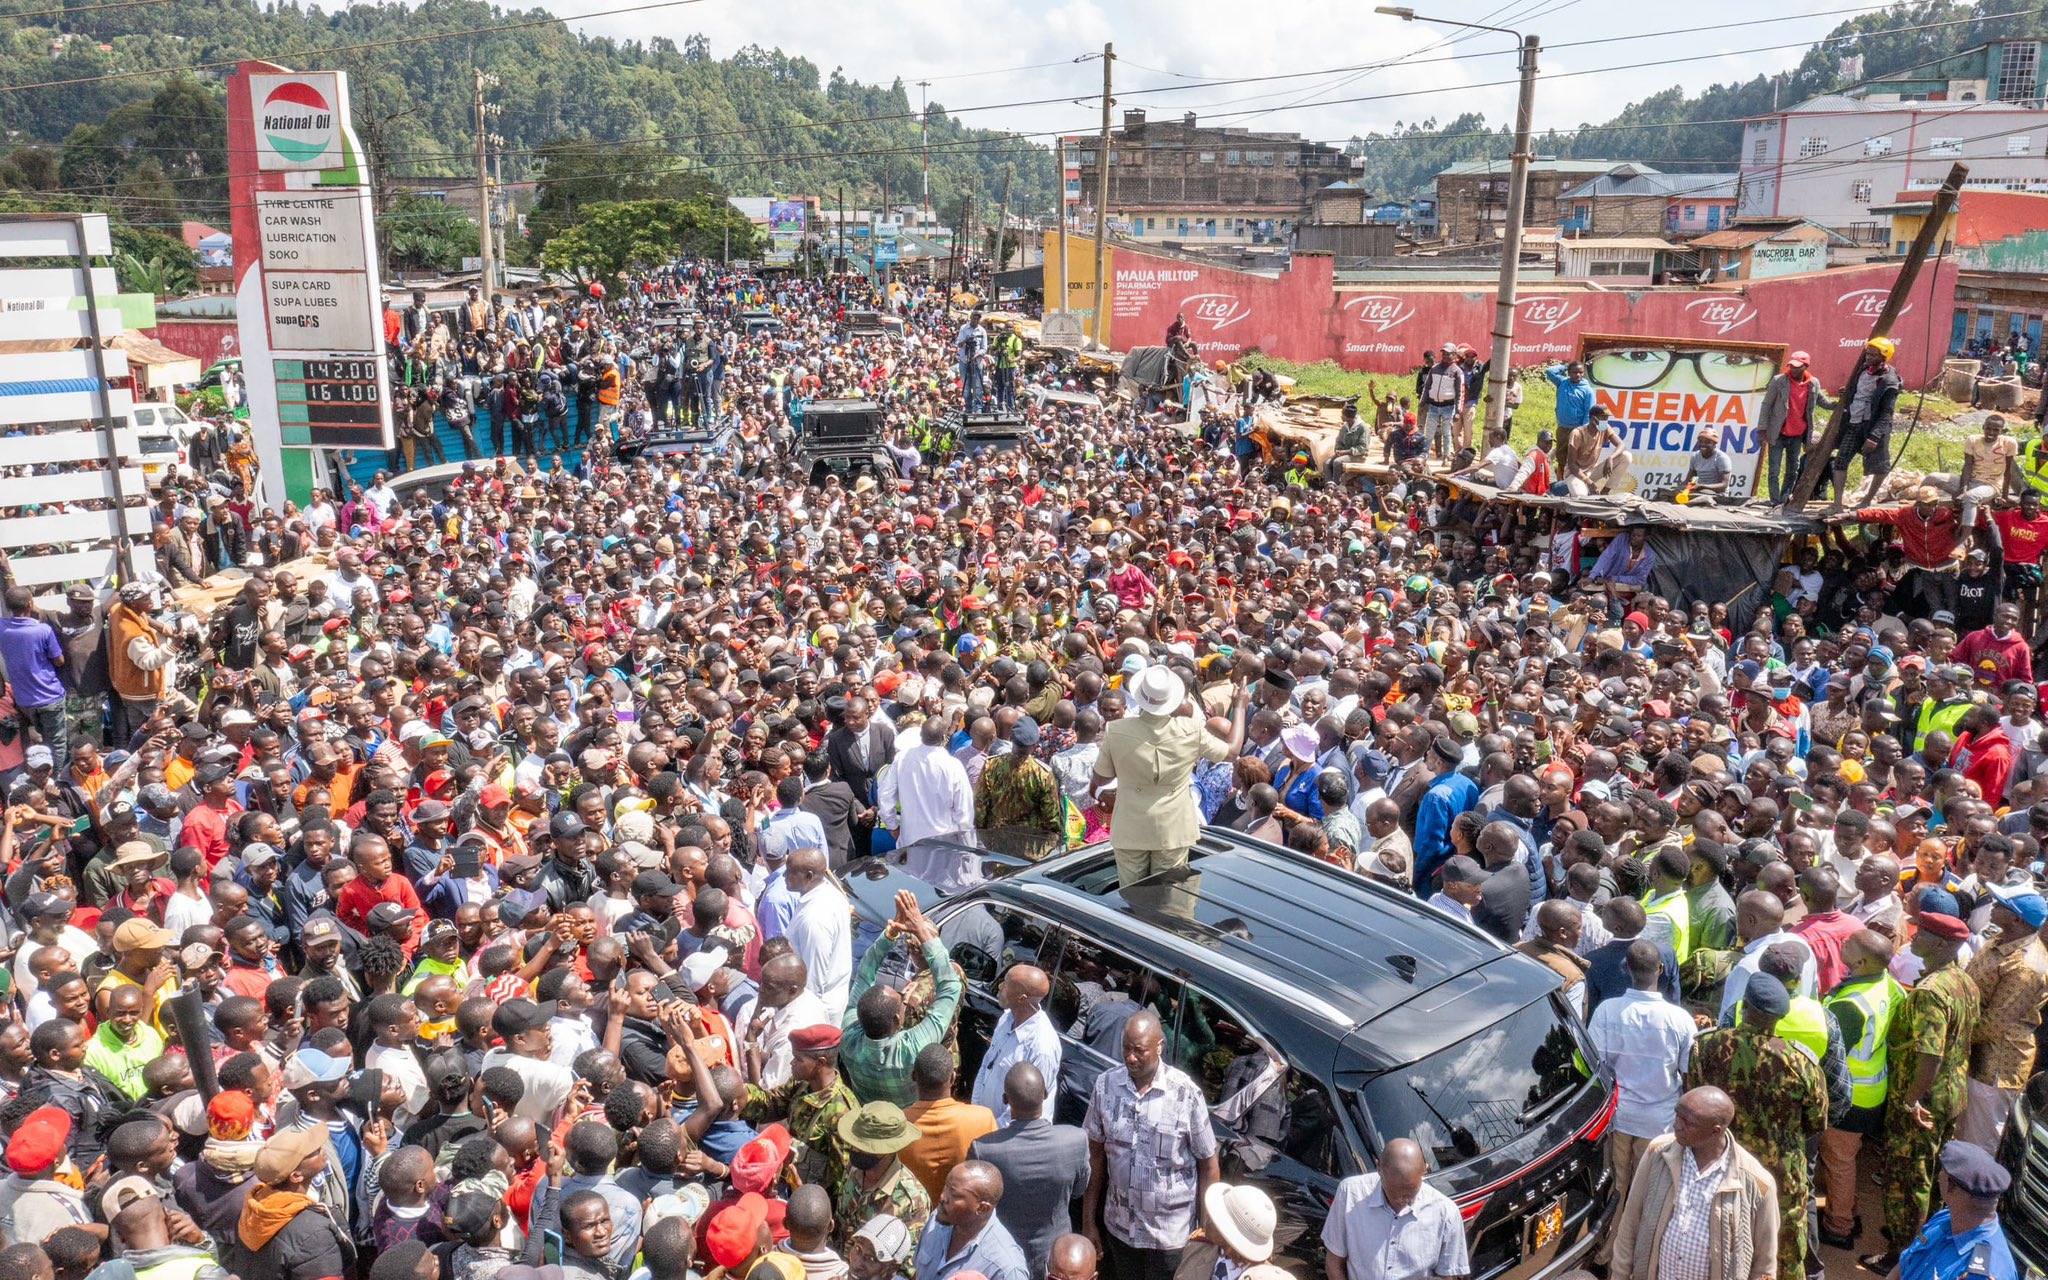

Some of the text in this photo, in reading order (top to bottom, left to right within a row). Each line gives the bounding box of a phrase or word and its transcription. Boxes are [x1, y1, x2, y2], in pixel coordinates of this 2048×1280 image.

[263, 114, 331, 130] National Oil
[264, 200, 334, 209] TYRE CENTRE
[265, 216, 321, 225] CAR WASH
[266, 233, 337, 242] LUBRICATION
[269, 250, 299, 259] SOKO
[1799, 248, 1816, 258] BAR
[1116, 270, 1199, 282] MAUA HILLTOP
[272, 281, 331, 290] SUPA CARD
[7, 300, 45, 311] National Oil
[273, 297, 337, 307] SUPA LUBES
[1196, 299, 1240, 318] itel
[1855, 295, 1888, 313] ite
[1360, 300, 1404, 320] itel
[1524, 301, 1569, 320] itel
[1701, 302, 1746, 320] itel
[275, 314, 320, 328] supaGAS
[1211, 342, 1241, 351] Phone
[1345, 342, 1405, 352] Smart Phone
[1512, 342, 1572, 352] Smart Phone
[309, 362, 375, 379] 142.00
[311, 384, 377, 401] 161.00
[1595, 389, 1748, 424] NEEMA
[1600, 420, 1762, 454] PTICINS
[1508, 1159, 1579, 1212] LEXUS
